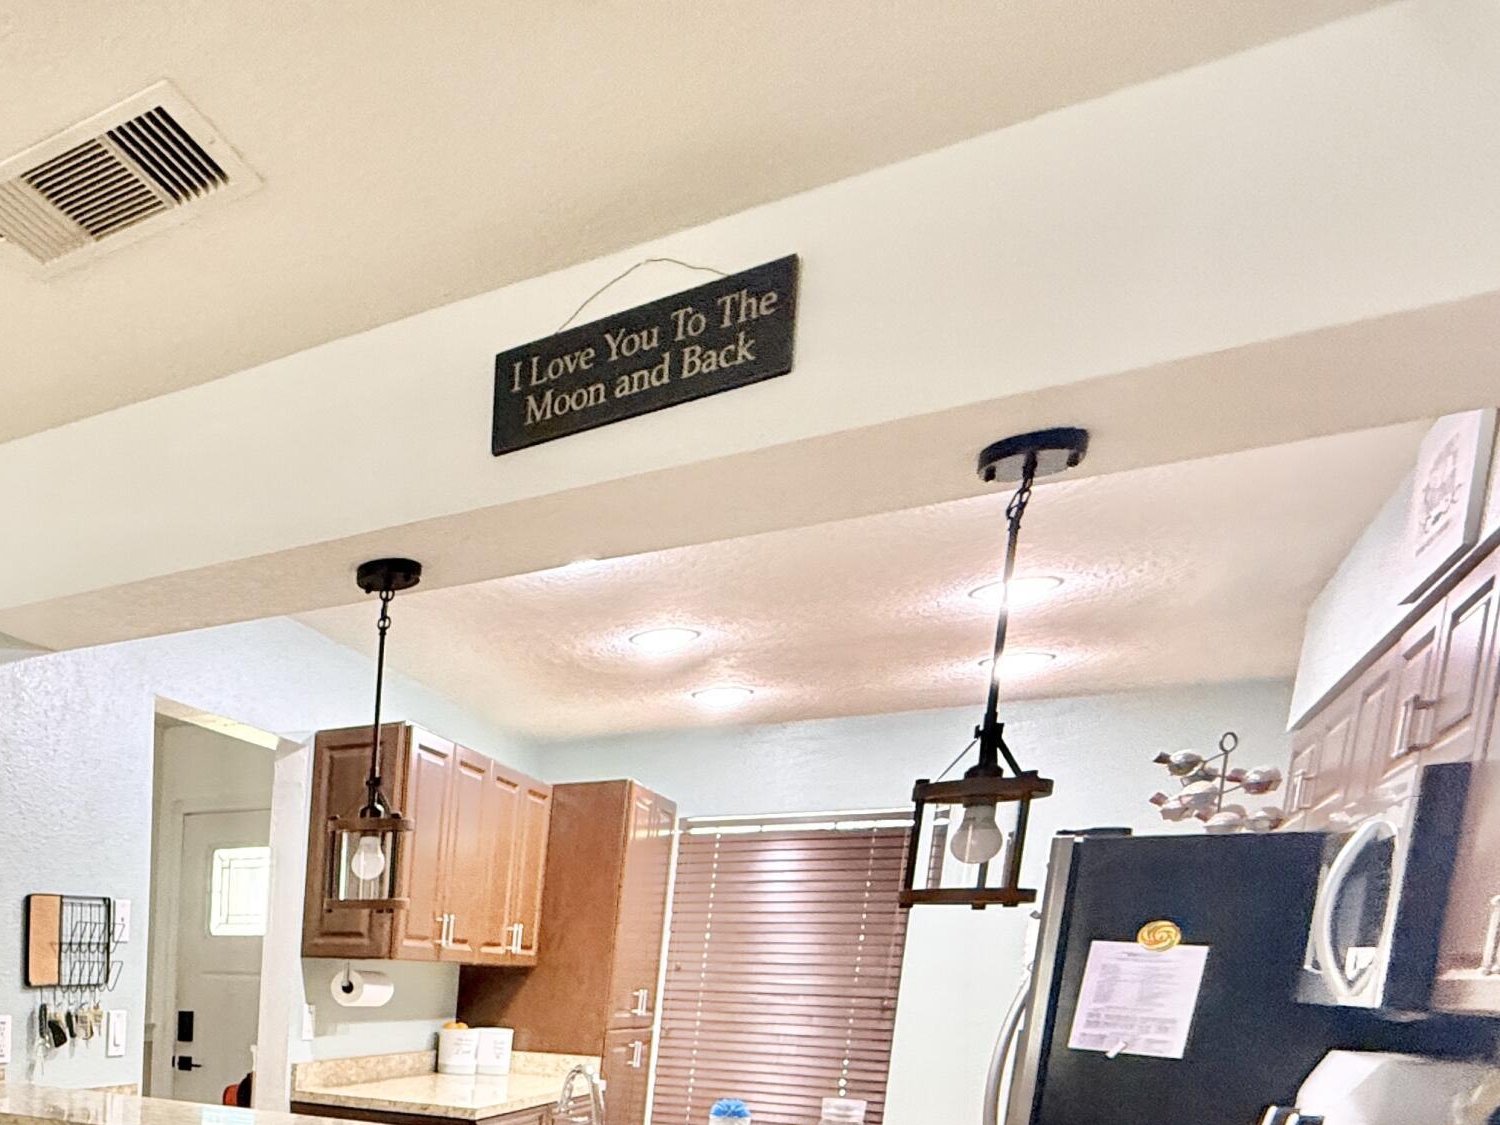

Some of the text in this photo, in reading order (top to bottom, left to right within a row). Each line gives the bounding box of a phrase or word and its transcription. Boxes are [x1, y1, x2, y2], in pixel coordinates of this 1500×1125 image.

[511, 289, 778, 392] I Love You To The
[524, 331, 756, 425] Moon and Back
